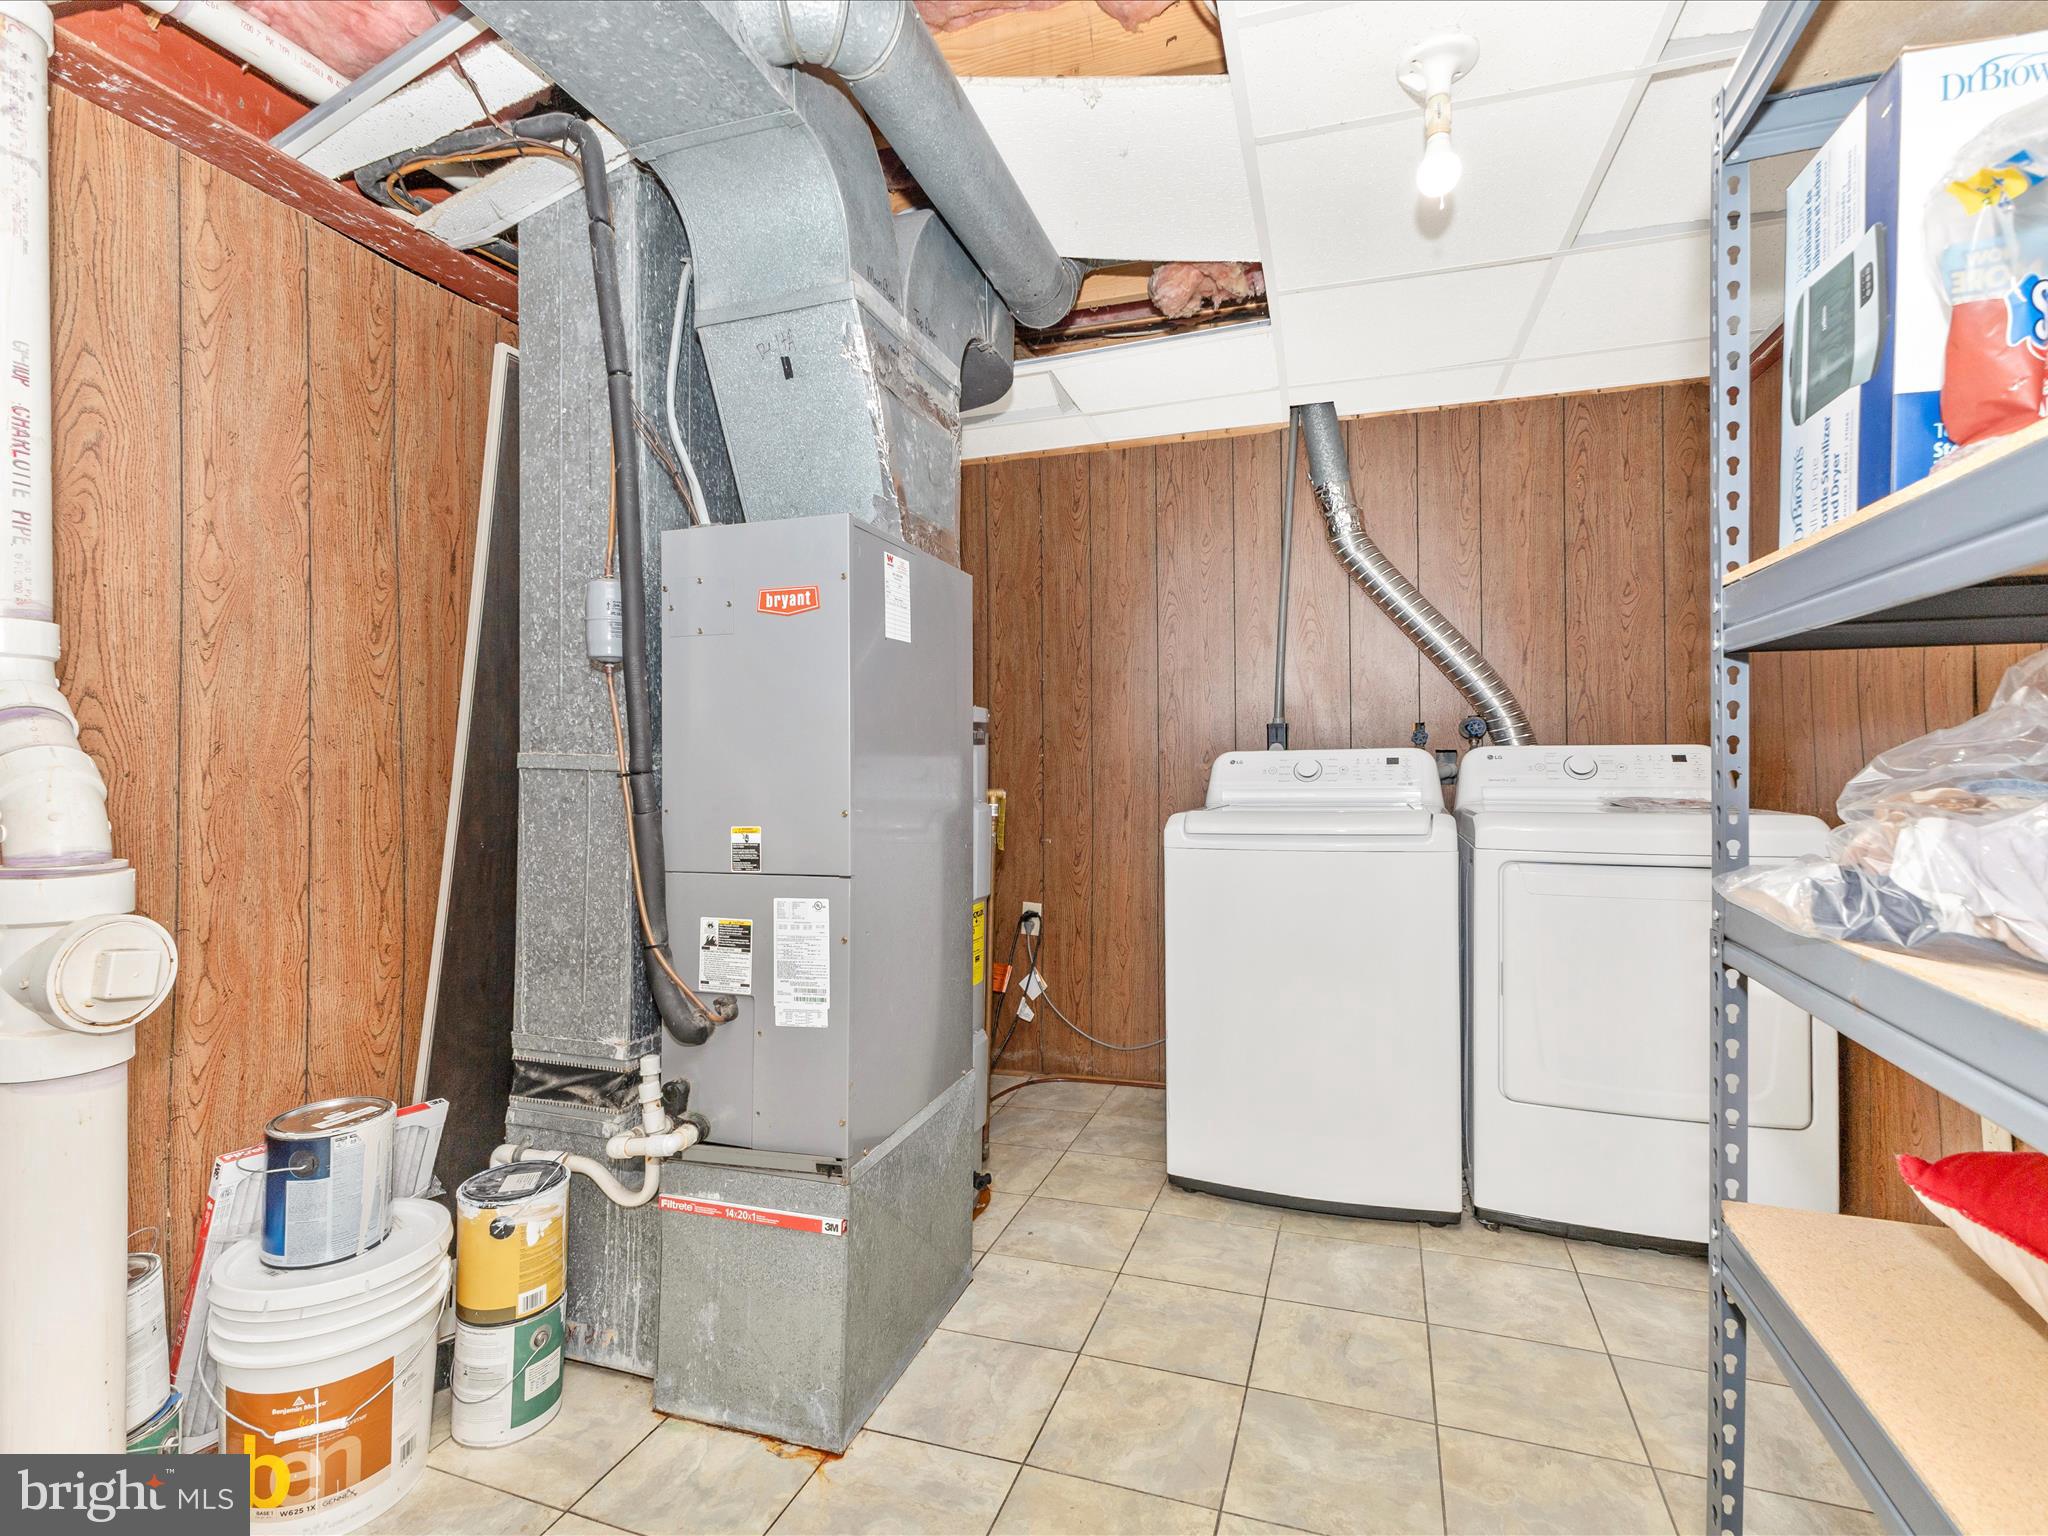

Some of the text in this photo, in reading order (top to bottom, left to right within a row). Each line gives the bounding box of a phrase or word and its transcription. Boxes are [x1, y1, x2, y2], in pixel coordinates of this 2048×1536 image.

[1821, 416, 1831, 485] Sterilizer
[1830, 453, 1842, 523] nd Dryer
[11, 509, 32, 546] PIPE
[766, 591, 811, 609] bryant
[660, 1199, 693, 1212] Filtrete
[725, 1207, 757, 1222] 14x20x1
[824, 1222, 839, 1233] 3M
[271, 1406, 302, 1415] Benjamin
[244, 1434, 361, 1508] ben
[280, 1504, 317, 1518] W625 1X
